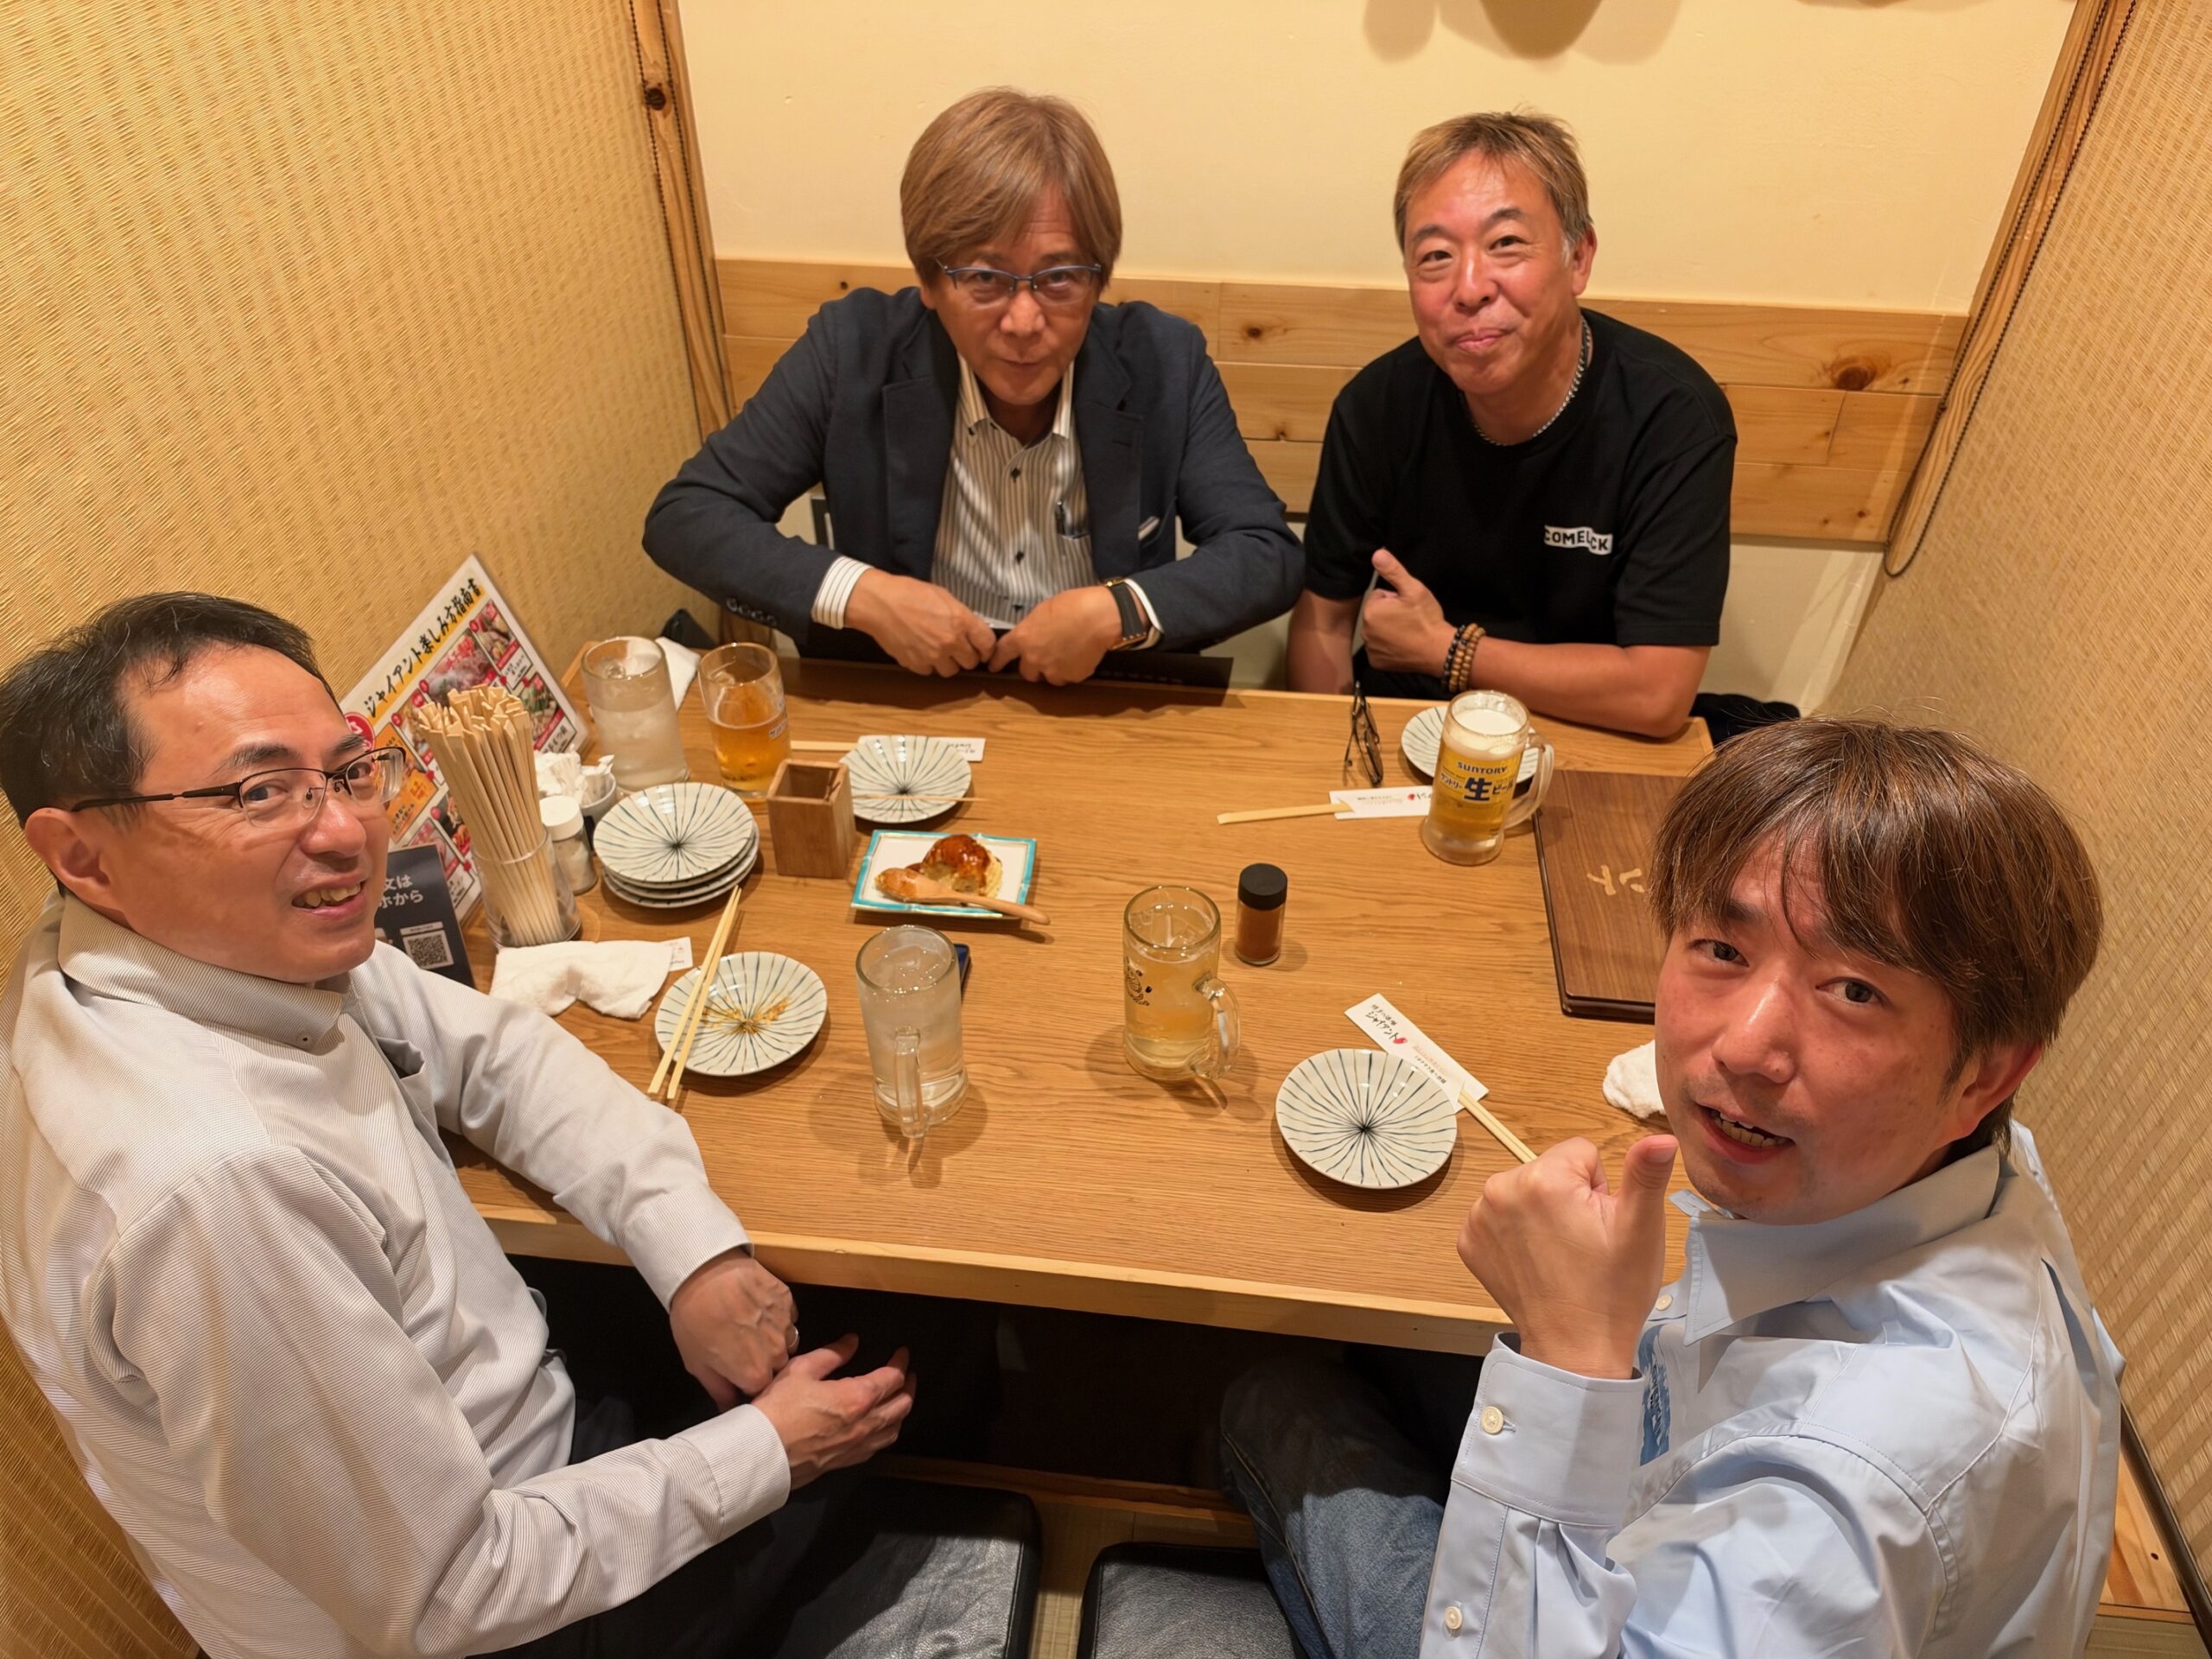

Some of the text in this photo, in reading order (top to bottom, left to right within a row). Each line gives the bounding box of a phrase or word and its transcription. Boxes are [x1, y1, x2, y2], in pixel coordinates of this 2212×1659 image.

[364, 578, 481, 718] ジャイアント楽しみ方指南書
[1458, 761, 1508, 775] SUNTORY
[378, 889, 423, 909] ホから
[1365, 1010, 1400, 1040] ジャイアント
